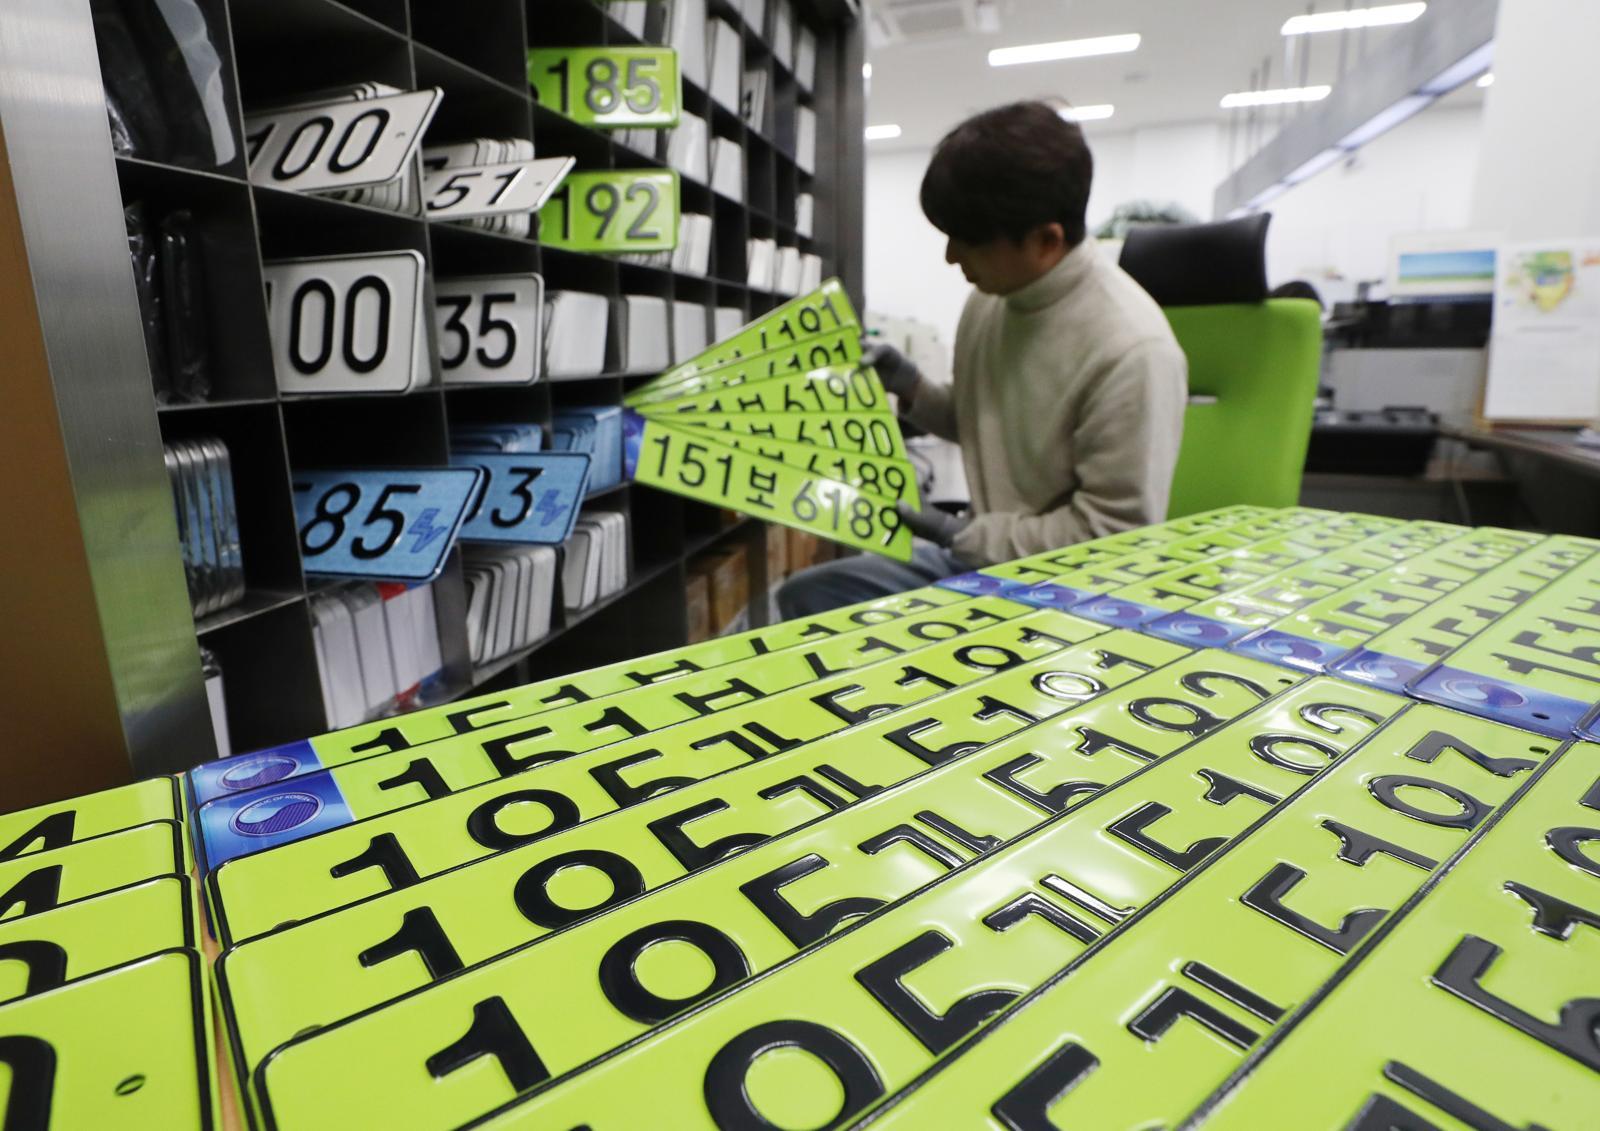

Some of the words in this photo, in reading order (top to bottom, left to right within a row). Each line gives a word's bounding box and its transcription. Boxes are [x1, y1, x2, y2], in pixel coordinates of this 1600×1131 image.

[427, 167, 524, 210] 51
[551, 182, 660, 240] 192
[267, 275, 391, 375] 00
[293, 482, 422, 560] 85
[792, 480, 901, 547] 6189
